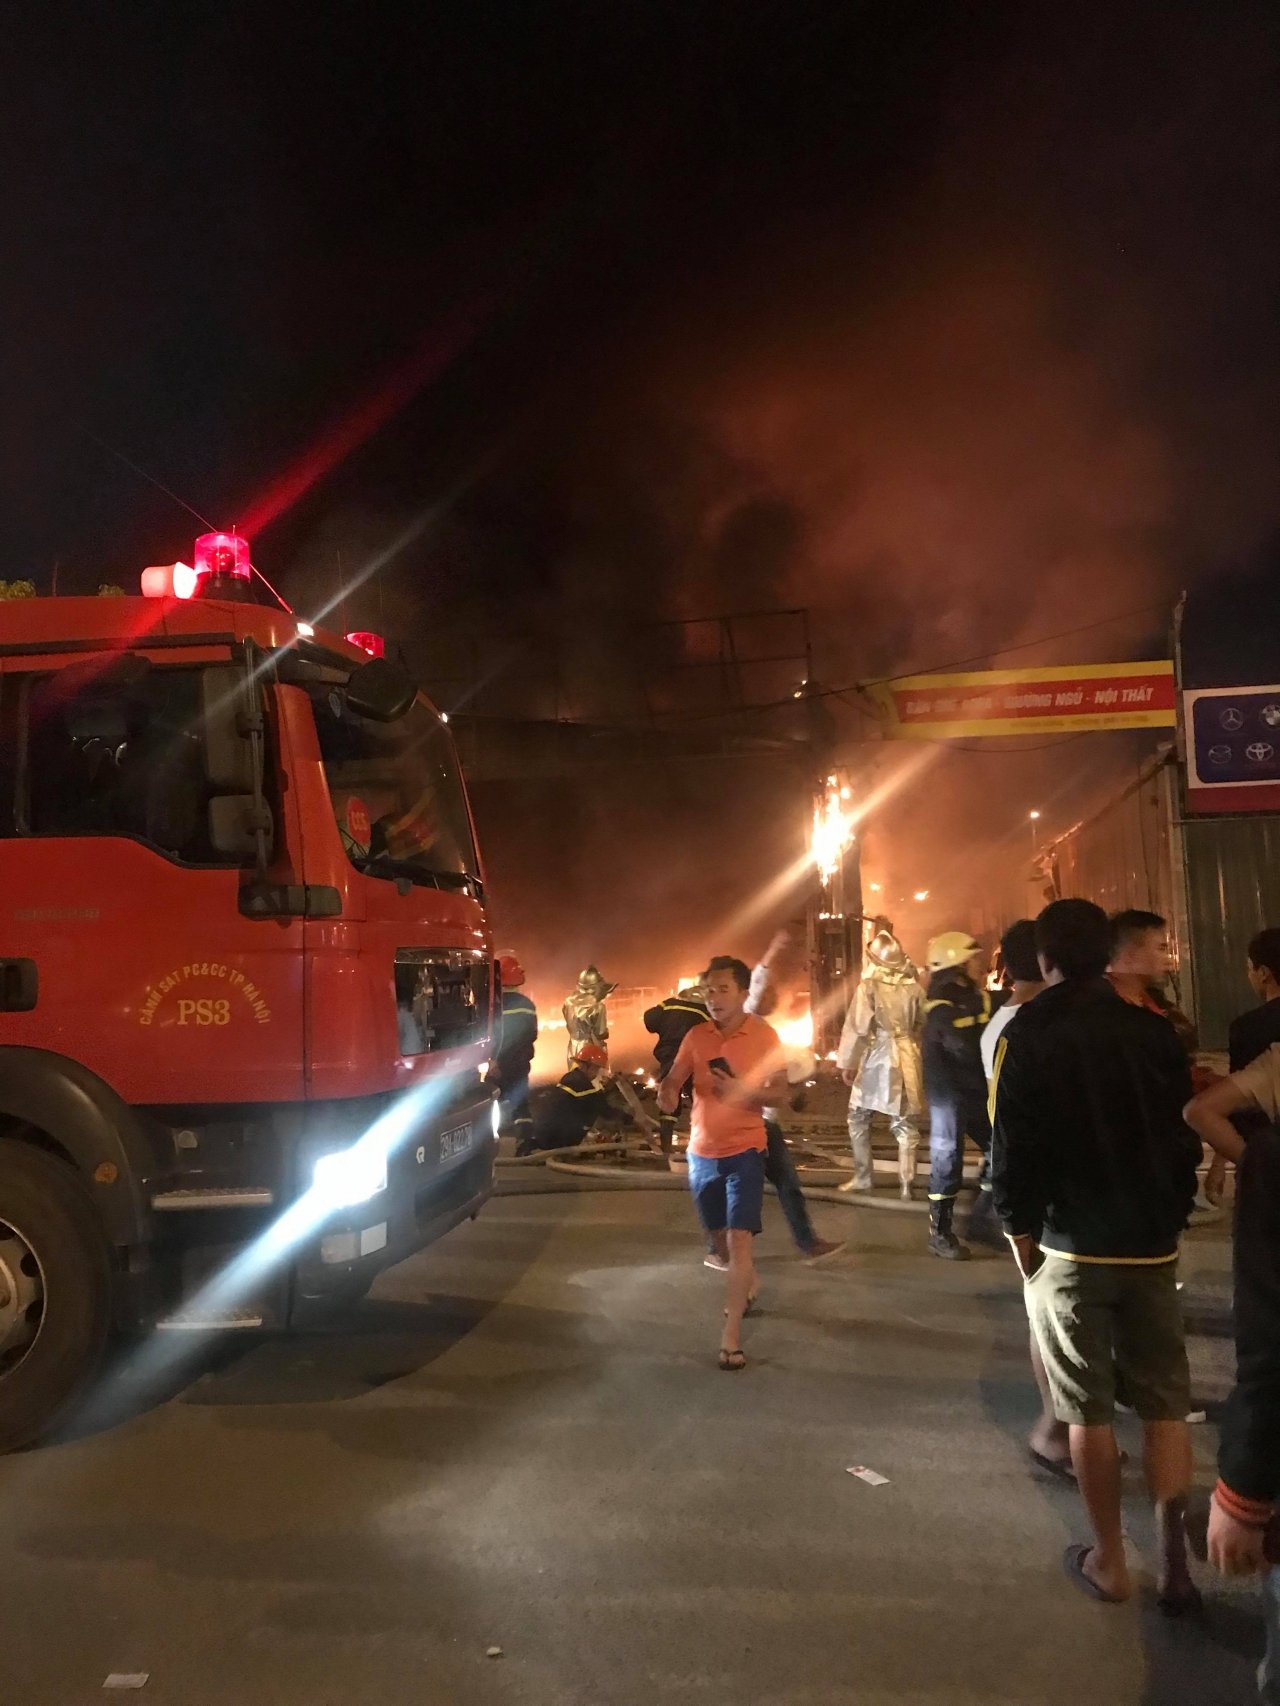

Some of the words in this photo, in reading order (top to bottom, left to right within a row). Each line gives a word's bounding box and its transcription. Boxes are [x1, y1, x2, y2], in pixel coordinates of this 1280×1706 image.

[1094, 687, 1118, 706] NỘI
[1120, 684, 1155, 703] THẤT
[183, 962, 227, 978] PC&CC
[228, 969, 245, 984] TP
[177, 999, 231, 1025] PS3
